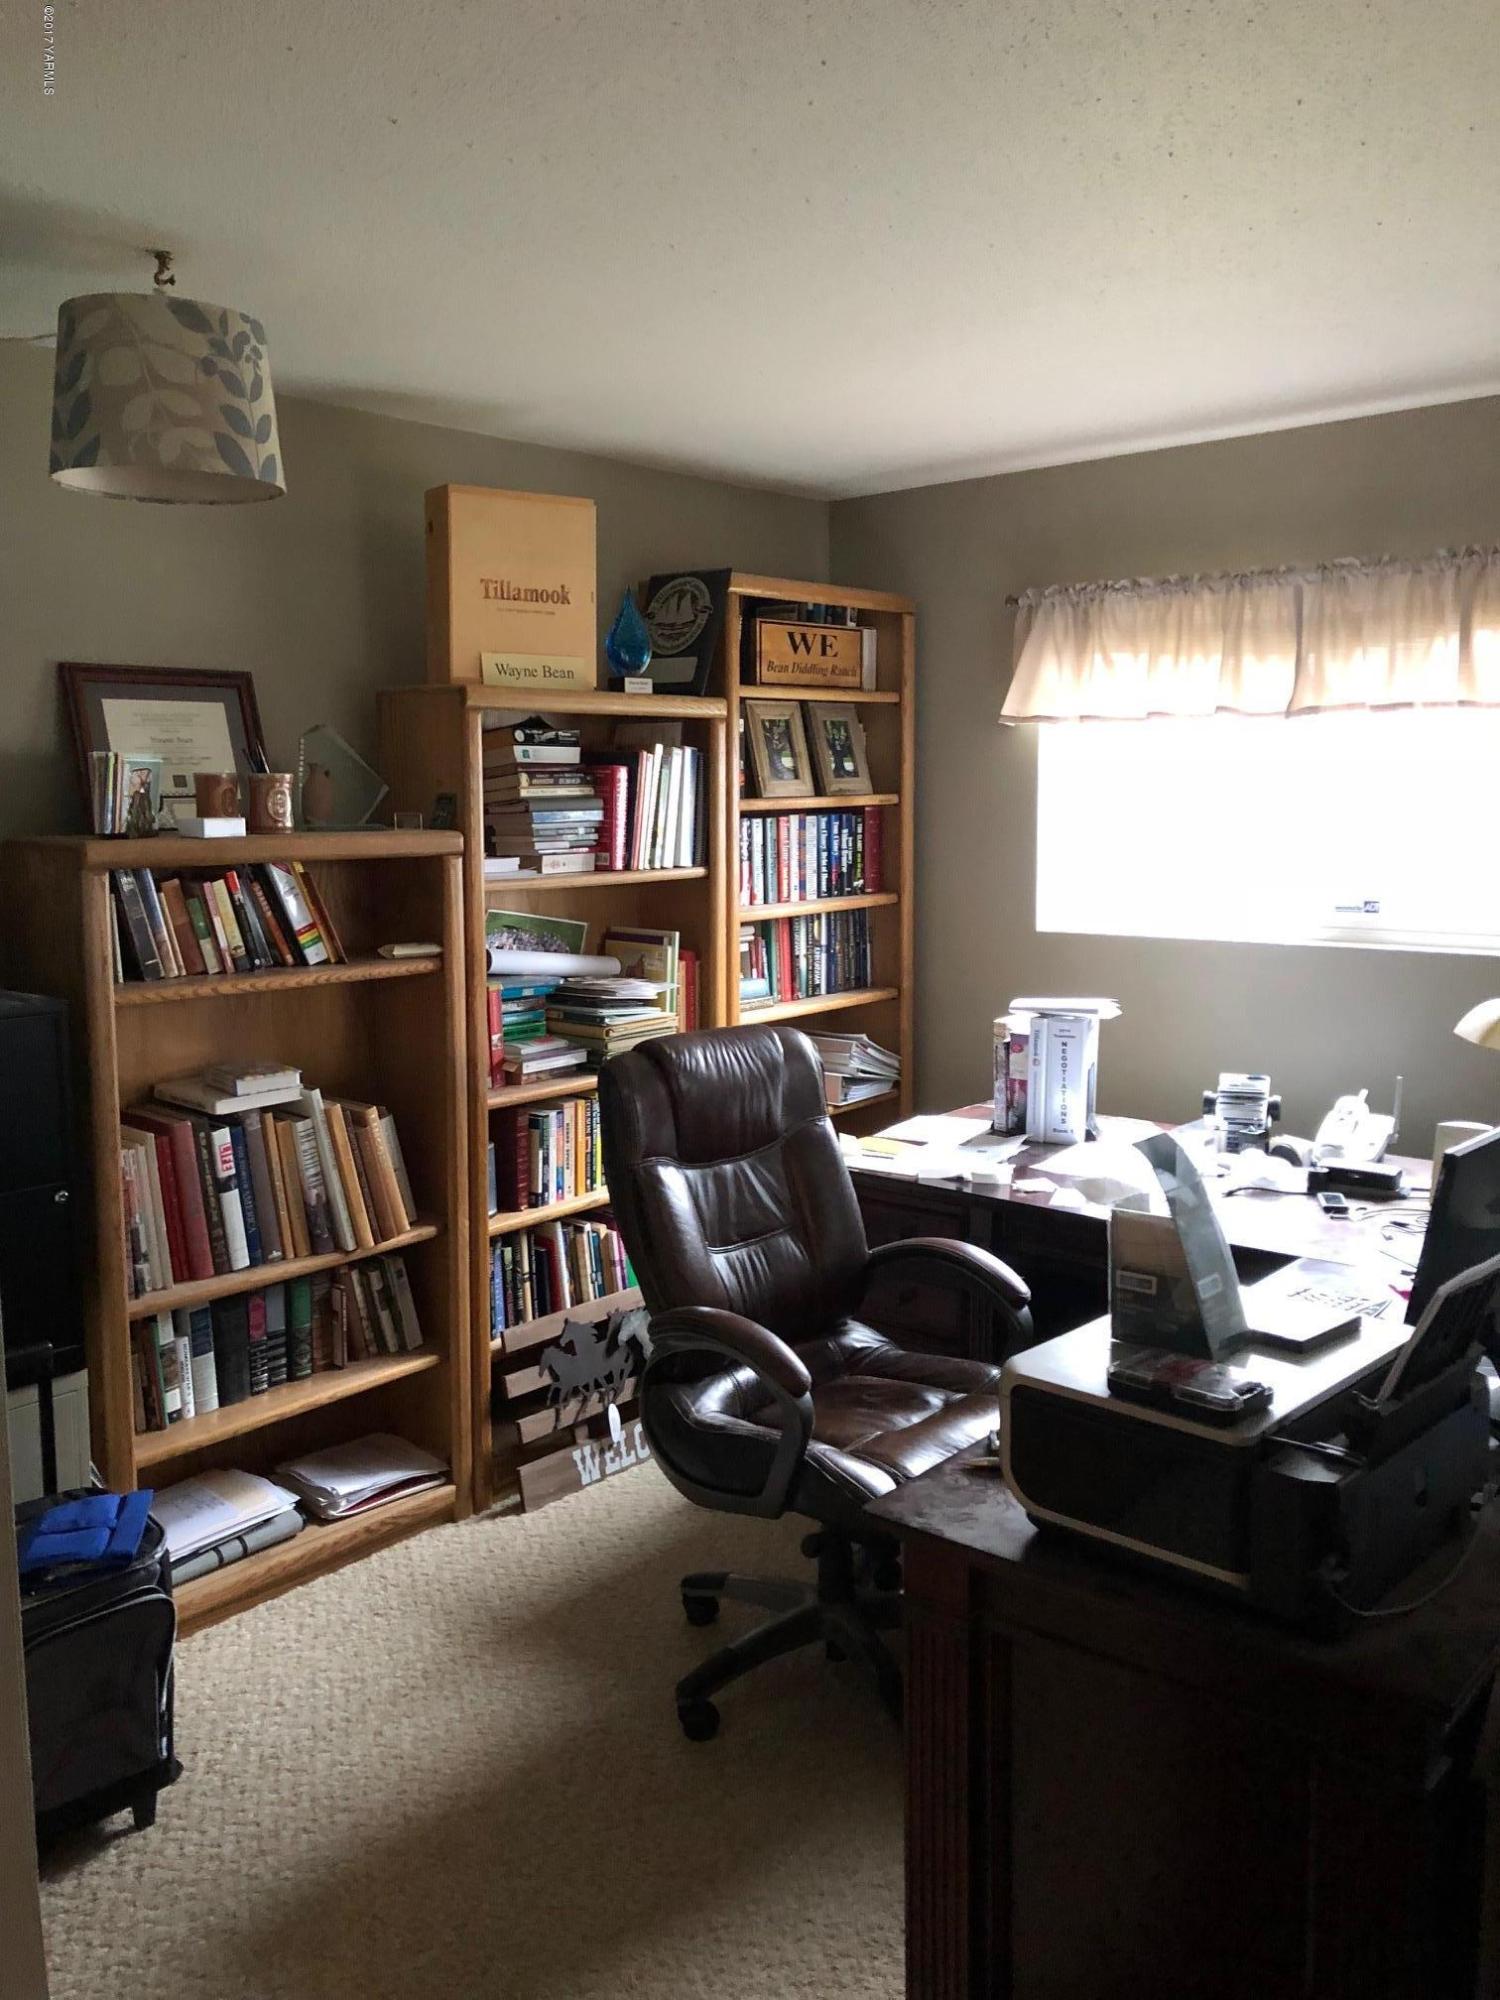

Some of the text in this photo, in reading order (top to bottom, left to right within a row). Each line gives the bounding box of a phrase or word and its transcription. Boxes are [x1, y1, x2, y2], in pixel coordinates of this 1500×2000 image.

[480, 578, 571, 605] Tillamook
[787, 631, 838, 658] WE
[495, 663, 574, 680] Wayne Bean
[766, 659, 790, 673] Bean
[1060, 1041, 1068, 1125] NEGOTIATIONS
[219, 1143, 233, 1173] LIFE
